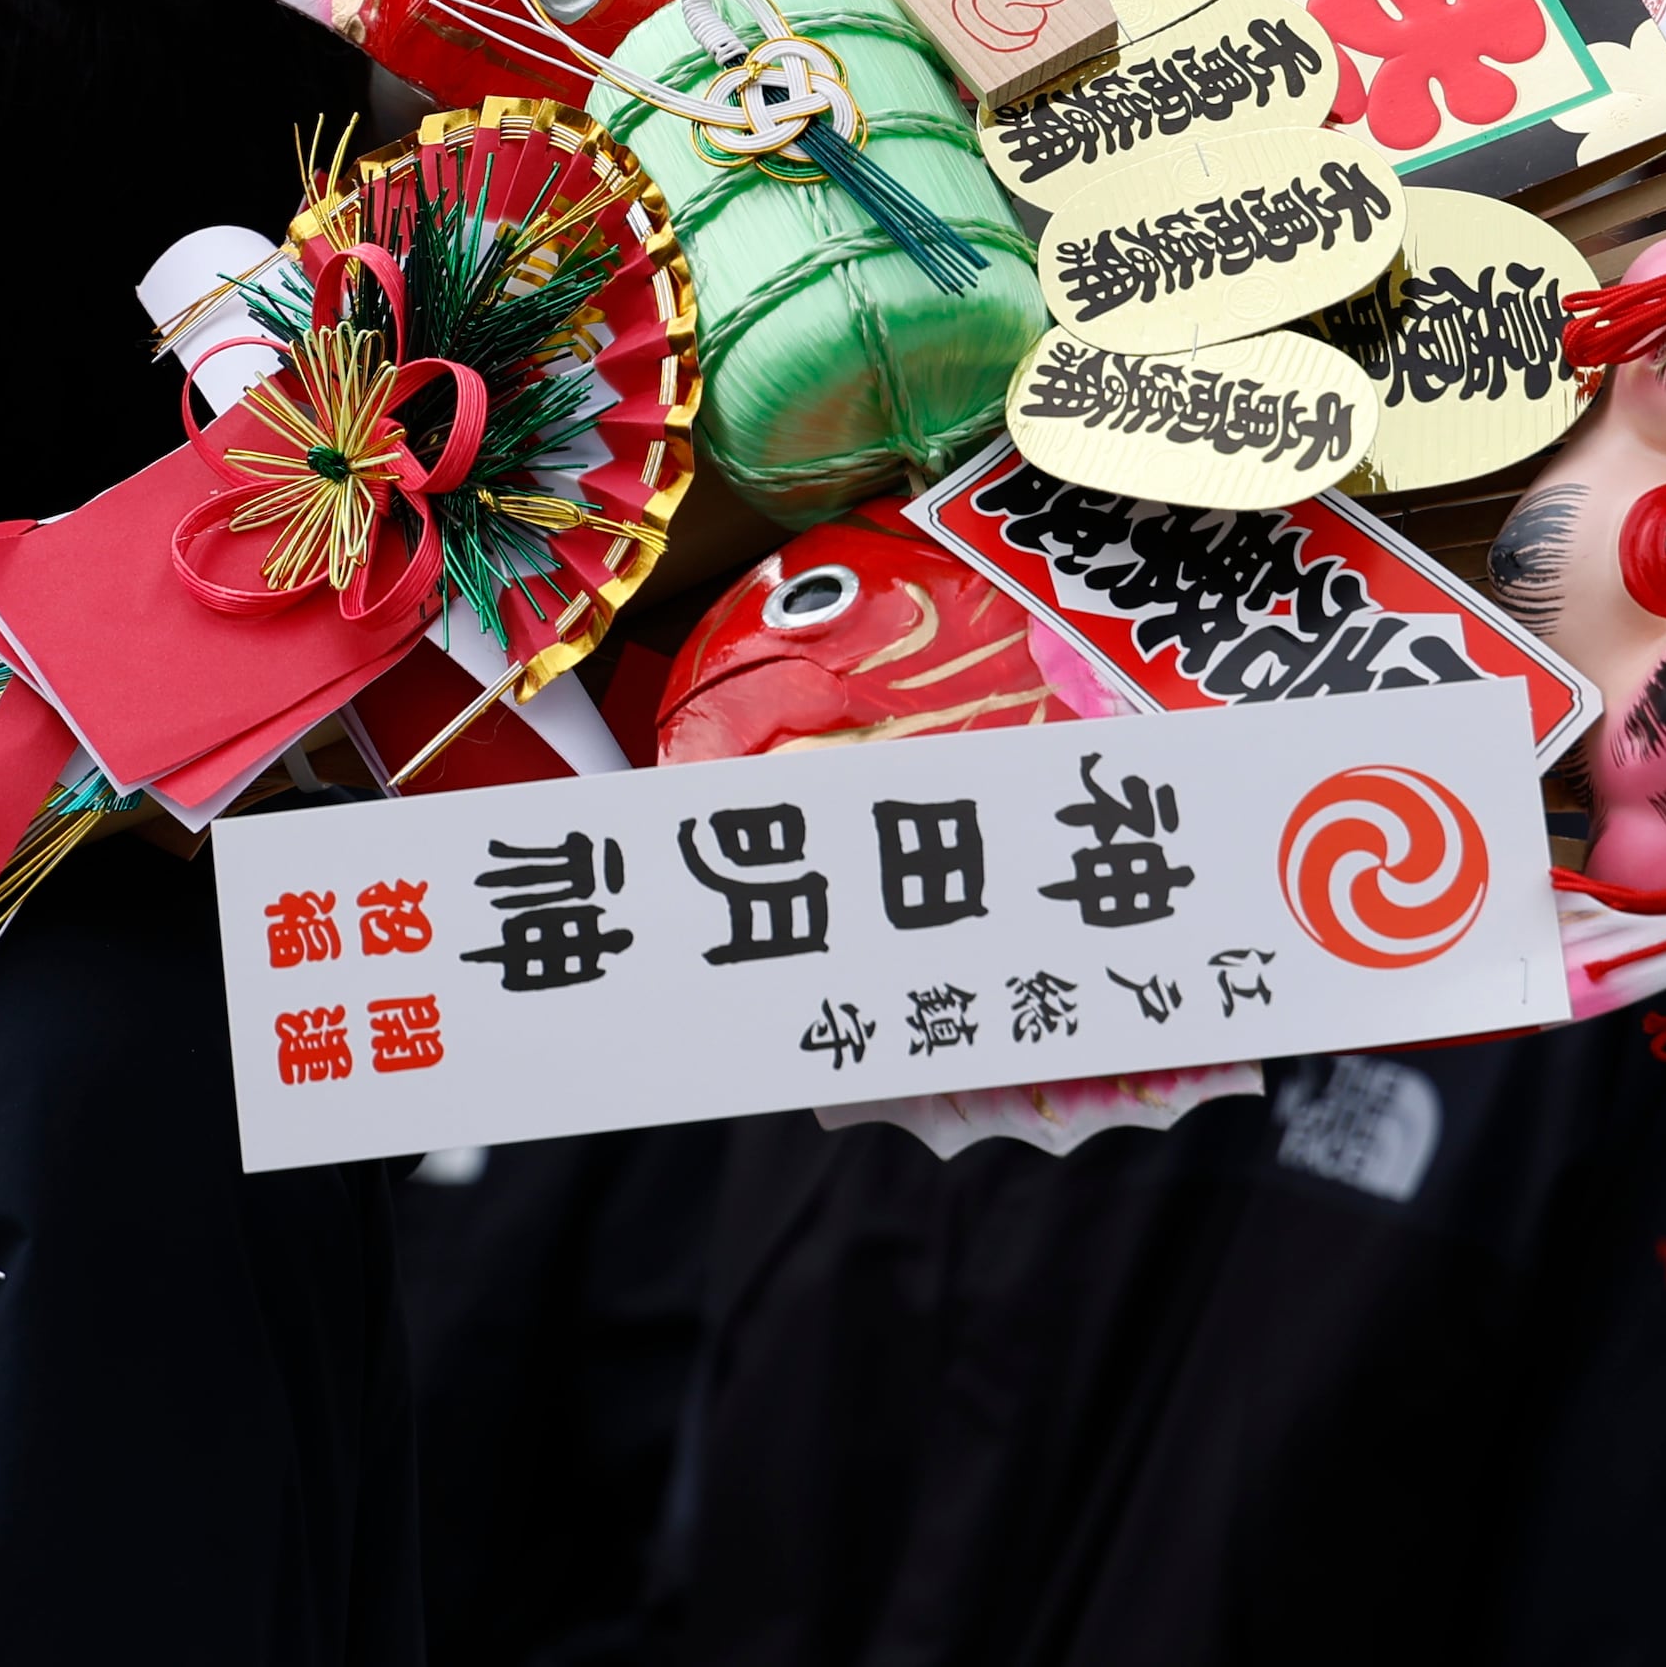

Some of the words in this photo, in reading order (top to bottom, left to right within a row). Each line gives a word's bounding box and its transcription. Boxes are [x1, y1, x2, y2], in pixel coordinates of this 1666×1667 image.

[458, 752, 1196, 993] 神田明神
[800, 947, 1280, 1070] 江戸総鎮守
